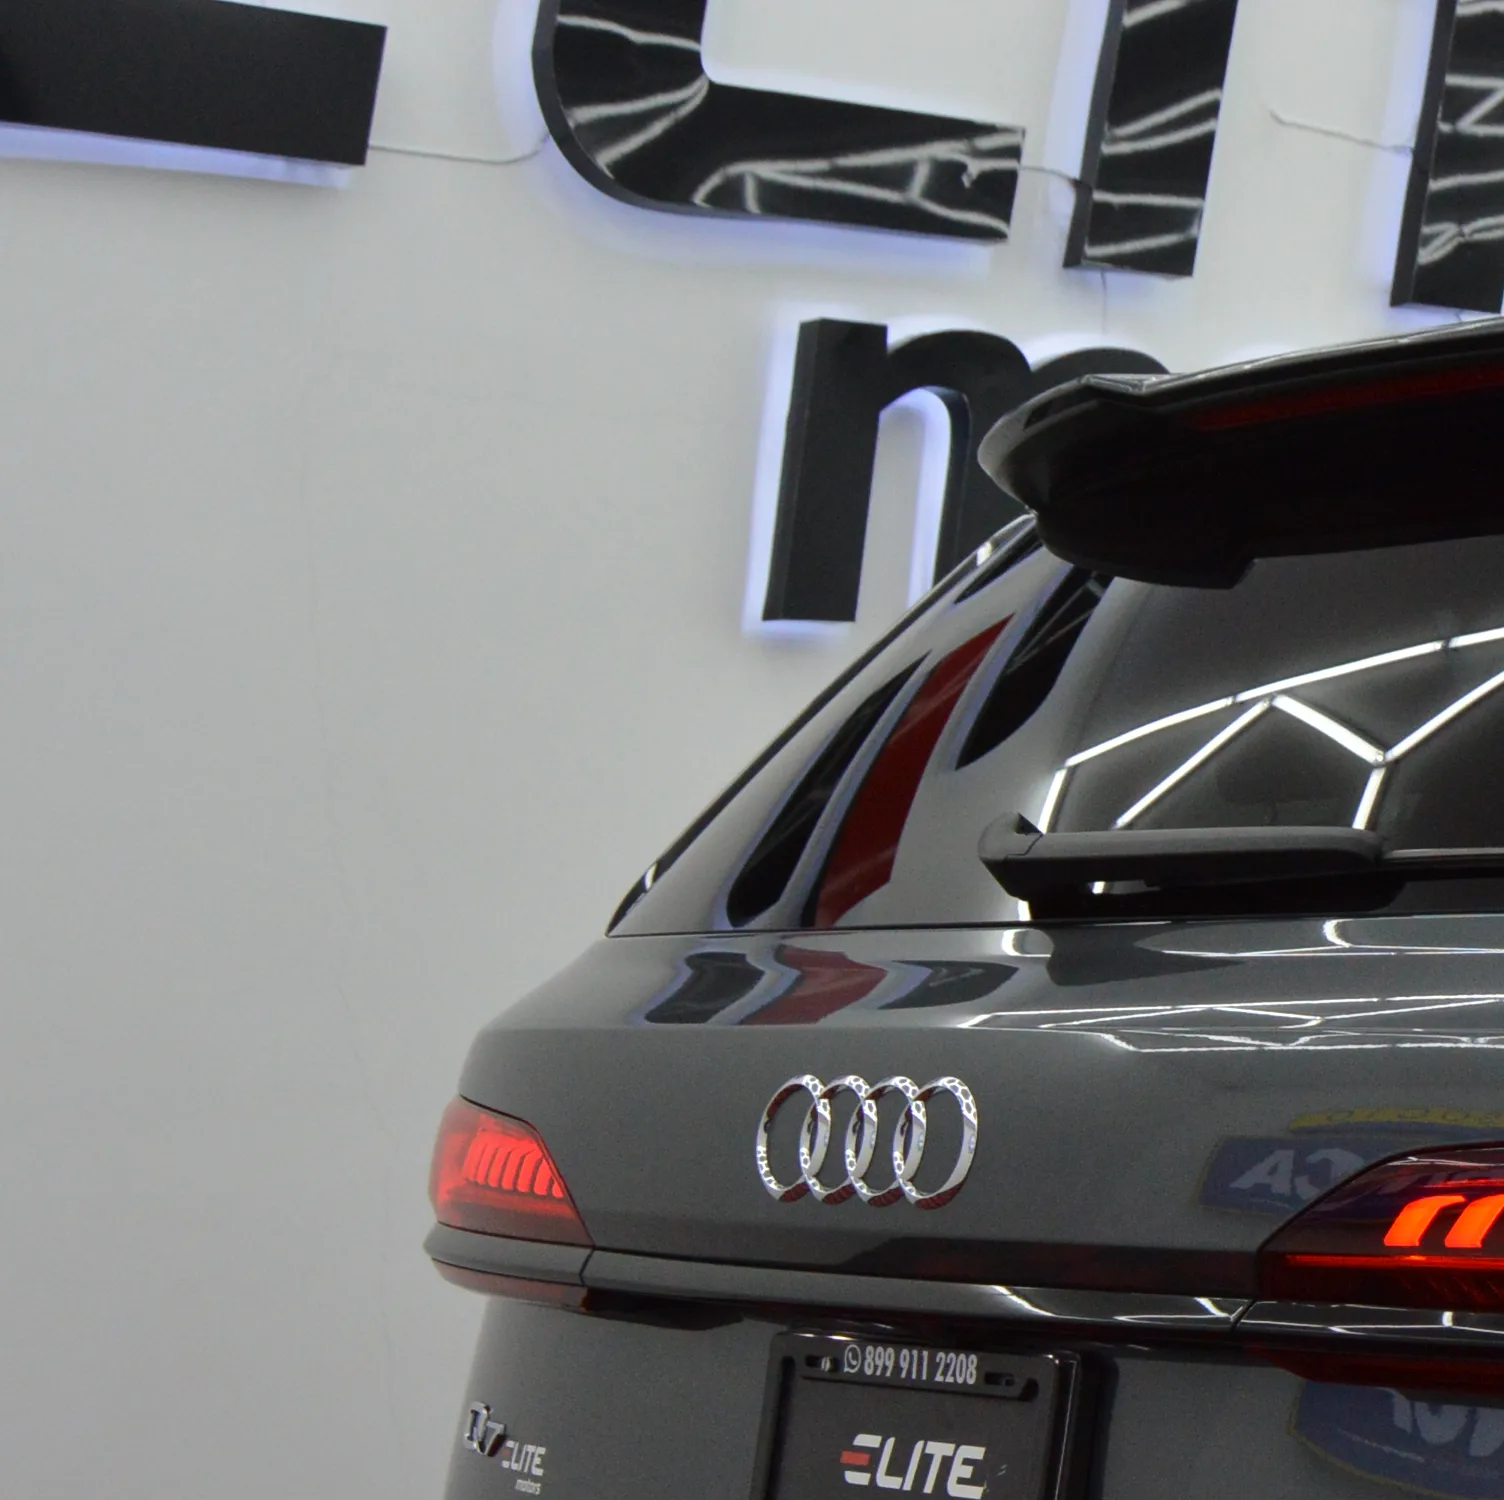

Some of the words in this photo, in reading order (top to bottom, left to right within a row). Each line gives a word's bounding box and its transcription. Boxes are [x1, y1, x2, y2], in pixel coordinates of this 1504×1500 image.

[864, 1346, 894, 1377] 899
[900, 1349, 928, 1380] 911
[935, 1352, 977, 1385] 2208
[501, 1440, 546, 1476] ELITE
[840, 1433, 986, 1500] ELITE
